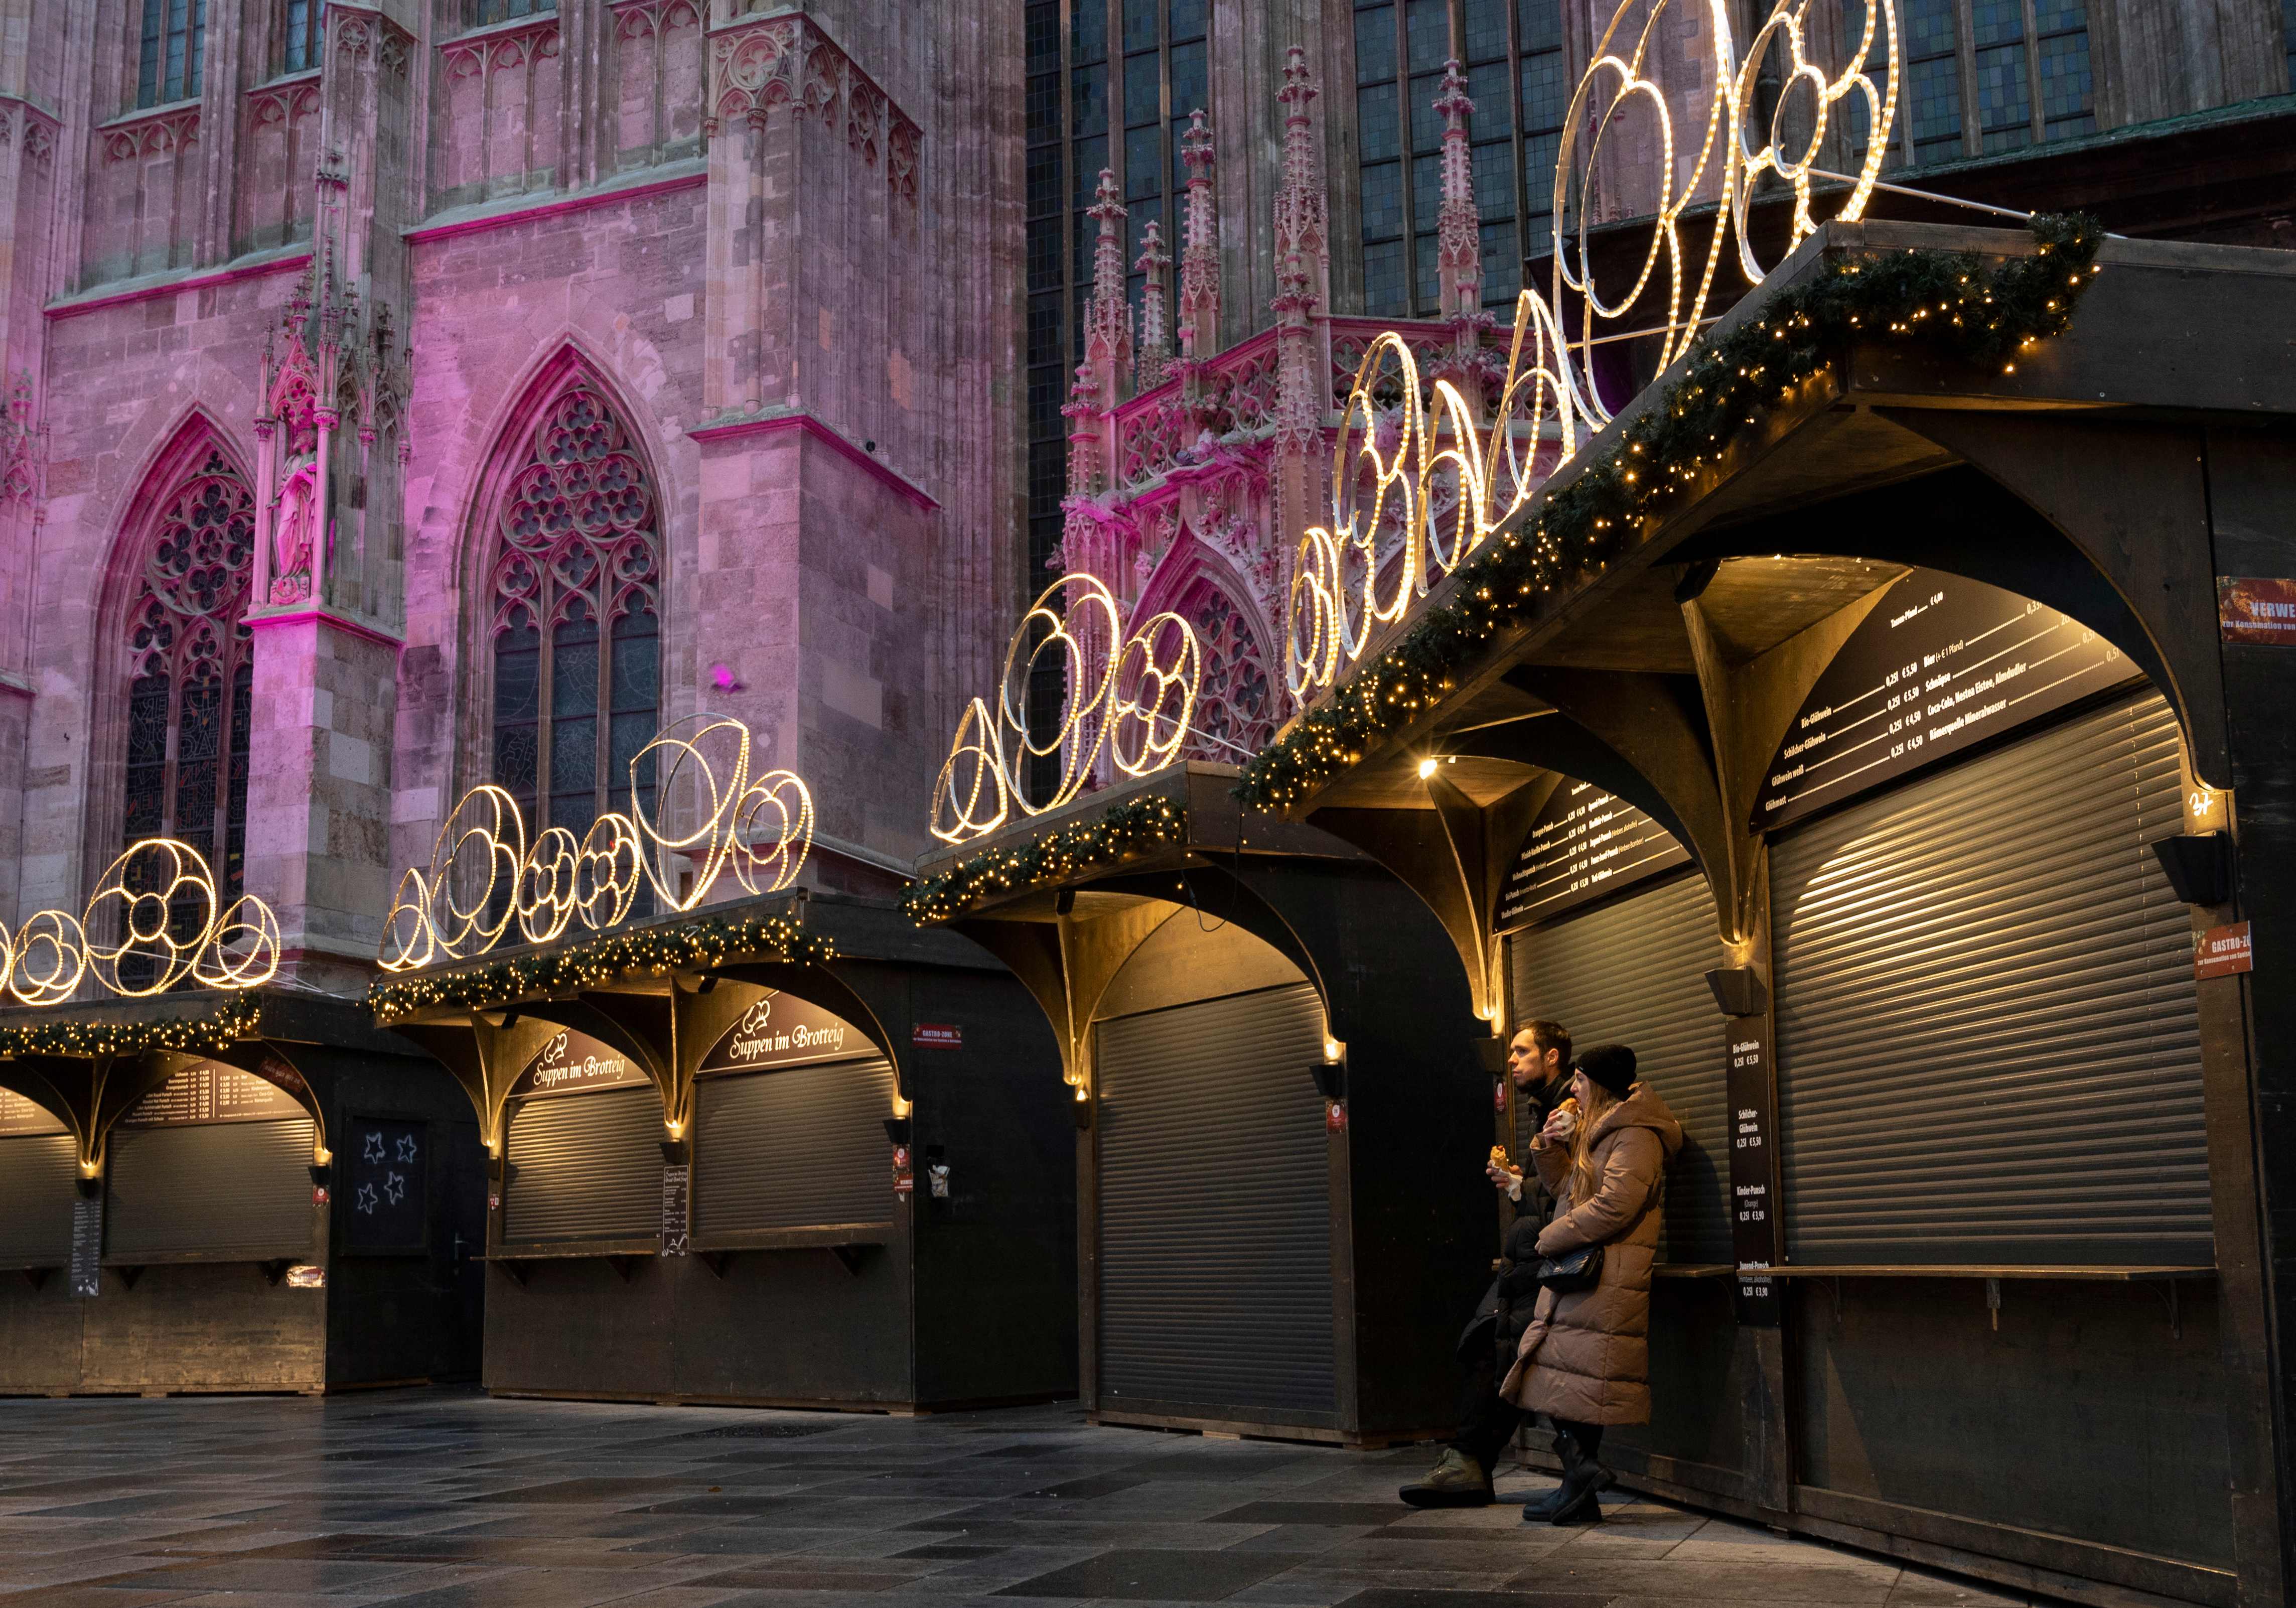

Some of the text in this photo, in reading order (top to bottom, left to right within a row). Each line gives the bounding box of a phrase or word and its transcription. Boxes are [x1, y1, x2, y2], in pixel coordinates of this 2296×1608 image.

[2235, 621, 2282, 630] Konsumation
[1801, 707, 1831, 729] Bio-Glühwein
[1924, 654, 1935, 667] Bier
[1772, 771, 1792, 786] Glühwein
[1793, 764, 1804, 777] weiß
[1927, 696, 1955, 716] Coca-Cola,
[1955, 687, 1975, 704] Nestea
[1975, 679, 1995, 694] Eistee,
[1995, 662, 2027, 685] Almdudler
[1784, 732, 1826, 759] Schilcher-Glühwein
[1925, 673, 1951, 692] Schnäpse
[1766, 795, 1786, 811] Glühmost
[1929, 717, 1964, 741] Römerquelle
[1964, 699, 2006, 725] Mineralwasser
[730, 1022, 844, 1061] Suppen im Brotteig
[922, 1030, 953, 1038] GASTRO-ZONE
[1733, 1039, 1759, 1054] Bio-Glühwein
[533, 1054, 625, 1088] Suppen im Brotteig
[1739, 1108, 1758, 1120] Schilcher-
[1739, 1122, 1758, 1134] Glühwein
[1737, 1184, 1765, 1196] Kinder-Punsch
